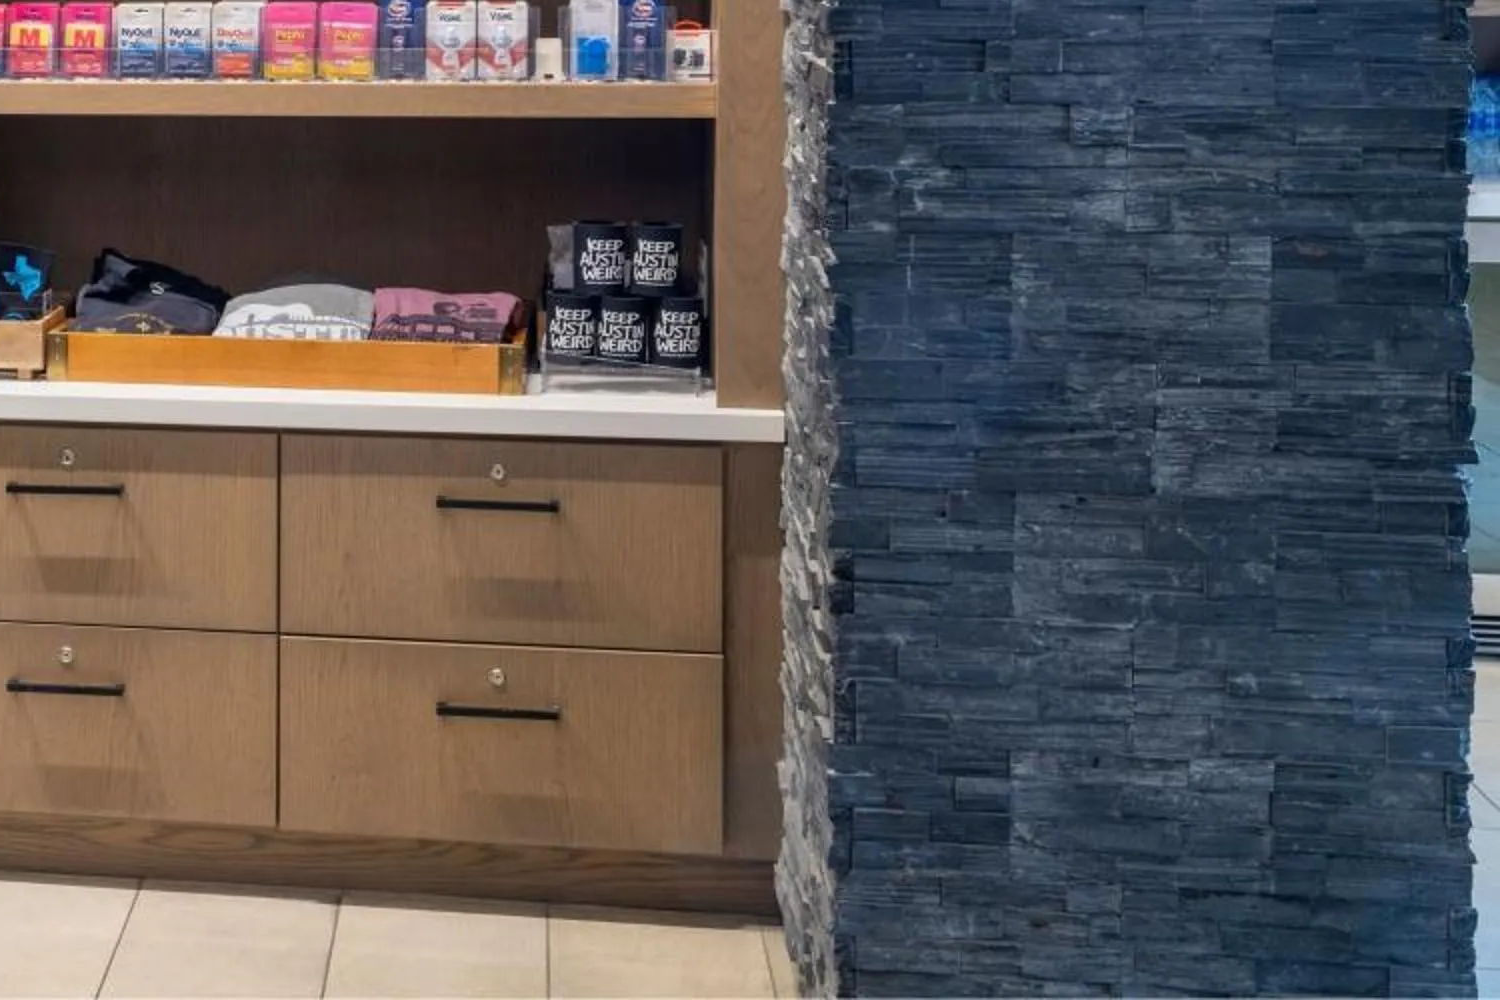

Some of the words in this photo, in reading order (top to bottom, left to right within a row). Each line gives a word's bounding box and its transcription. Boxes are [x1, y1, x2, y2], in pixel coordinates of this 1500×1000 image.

[587, 238, 623, 251] KEEP
[638, 239, 675, 253] KEEP
[633, 252, 678, 267] AUSTIN
[633, 267, 677, 281] WEIRD
[555, 305, 592, 320] KEEP
[602, 309, 640, 324] KEEP
[661, 309, 699, 325] KEEP
[550, 319, 595, 335] AUSTIN
[599, 322, 644, 338] AUSTIN
[551, 335, 595, 349] WEIRD
[600, 339, 642, 353] WEIRD
